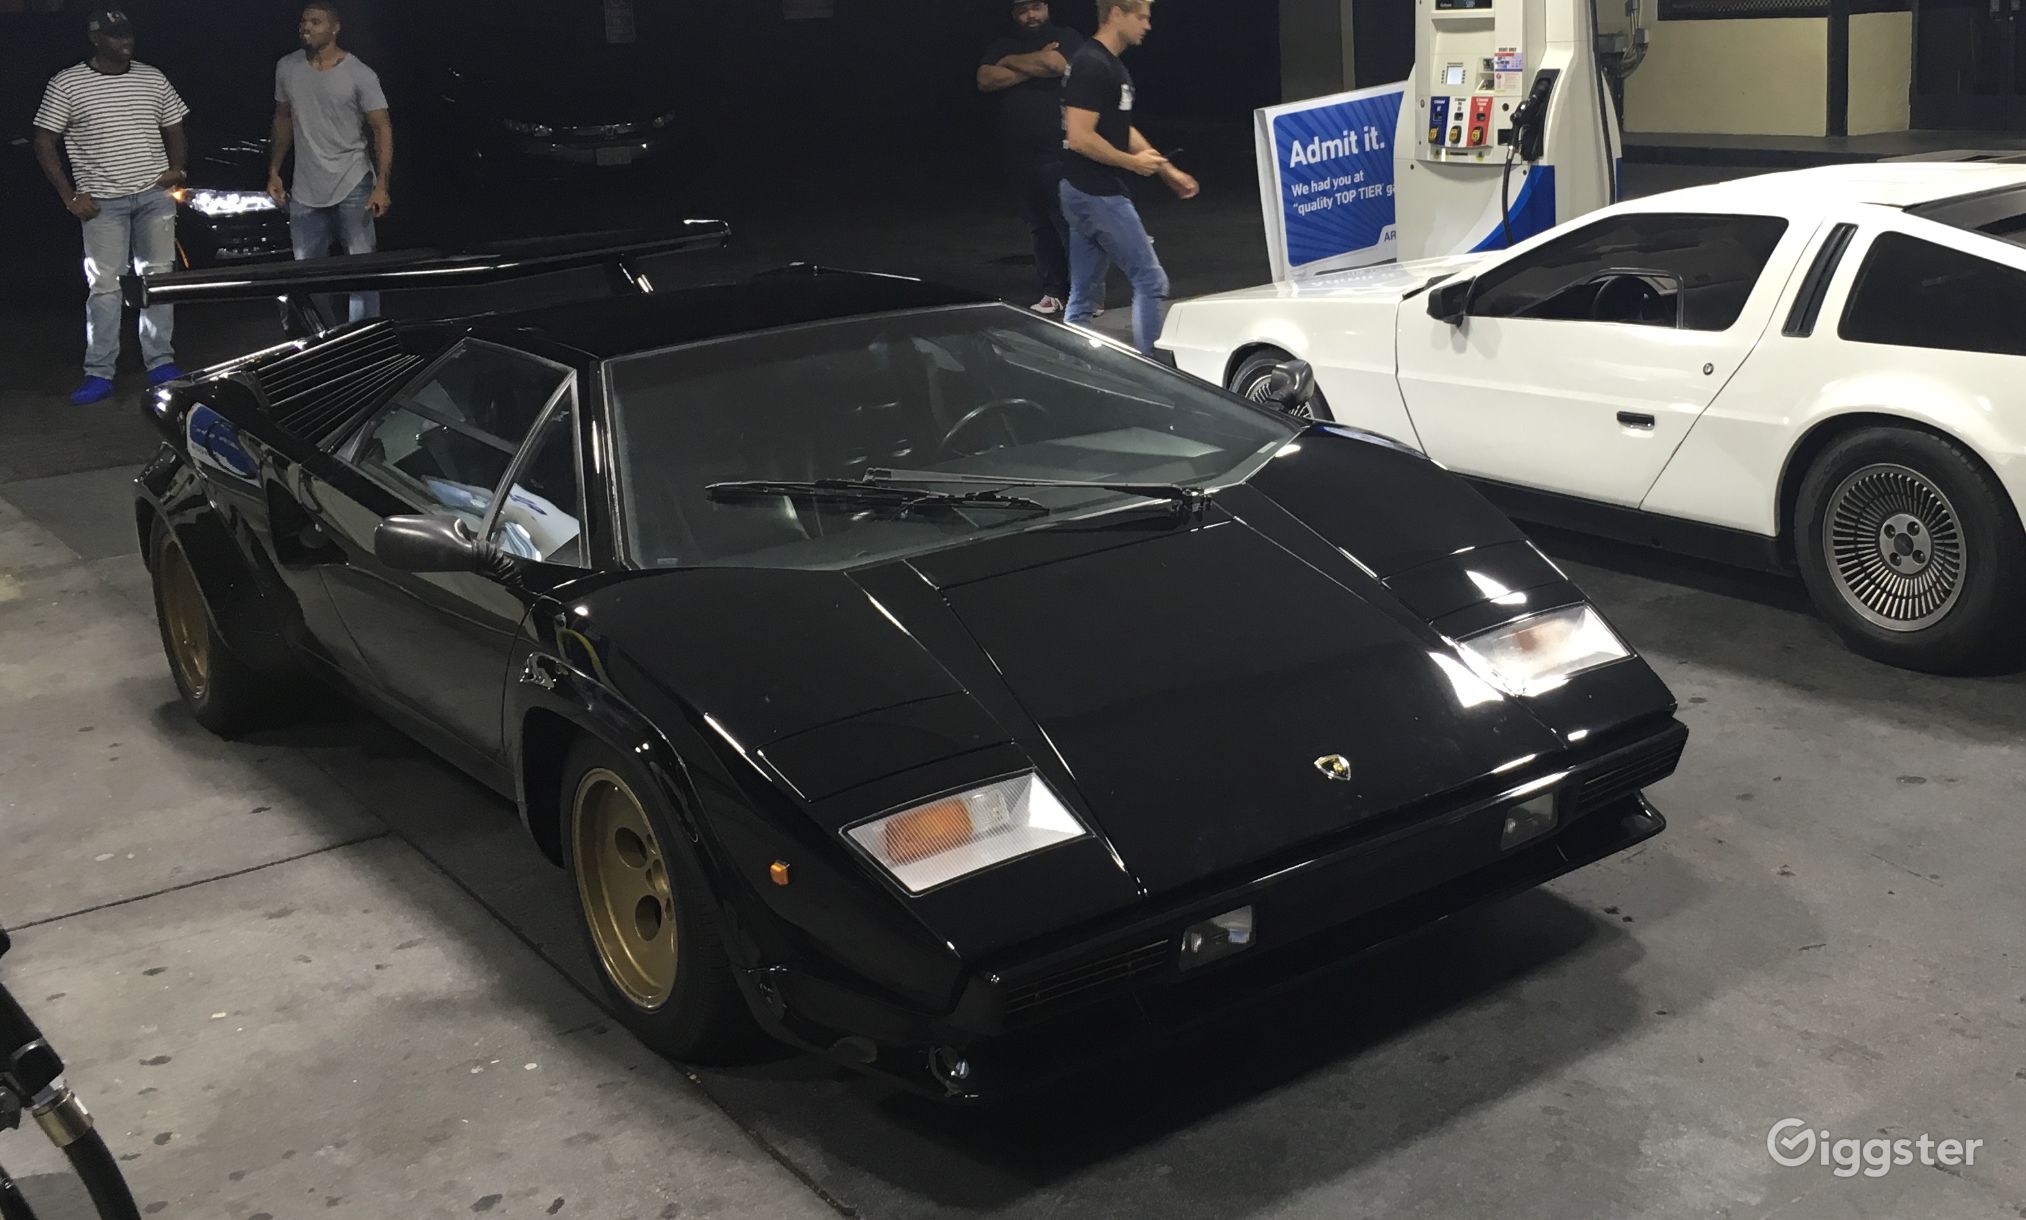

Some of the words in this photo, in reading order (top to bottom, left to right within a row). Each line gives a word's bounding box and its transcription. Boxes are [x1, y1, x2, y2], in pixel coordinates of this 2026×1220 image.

[1289, 130, 1358, 168] Admit
[1363, 126, 1385, 151] it.
[1291, 183, 1310, 197] We
[1311, 177, 1330, 193] had
[1332, 174, 1351, 190] you
[1353, 170, 1364, 181] at
[1335, 190, 1356, 205] TOP
